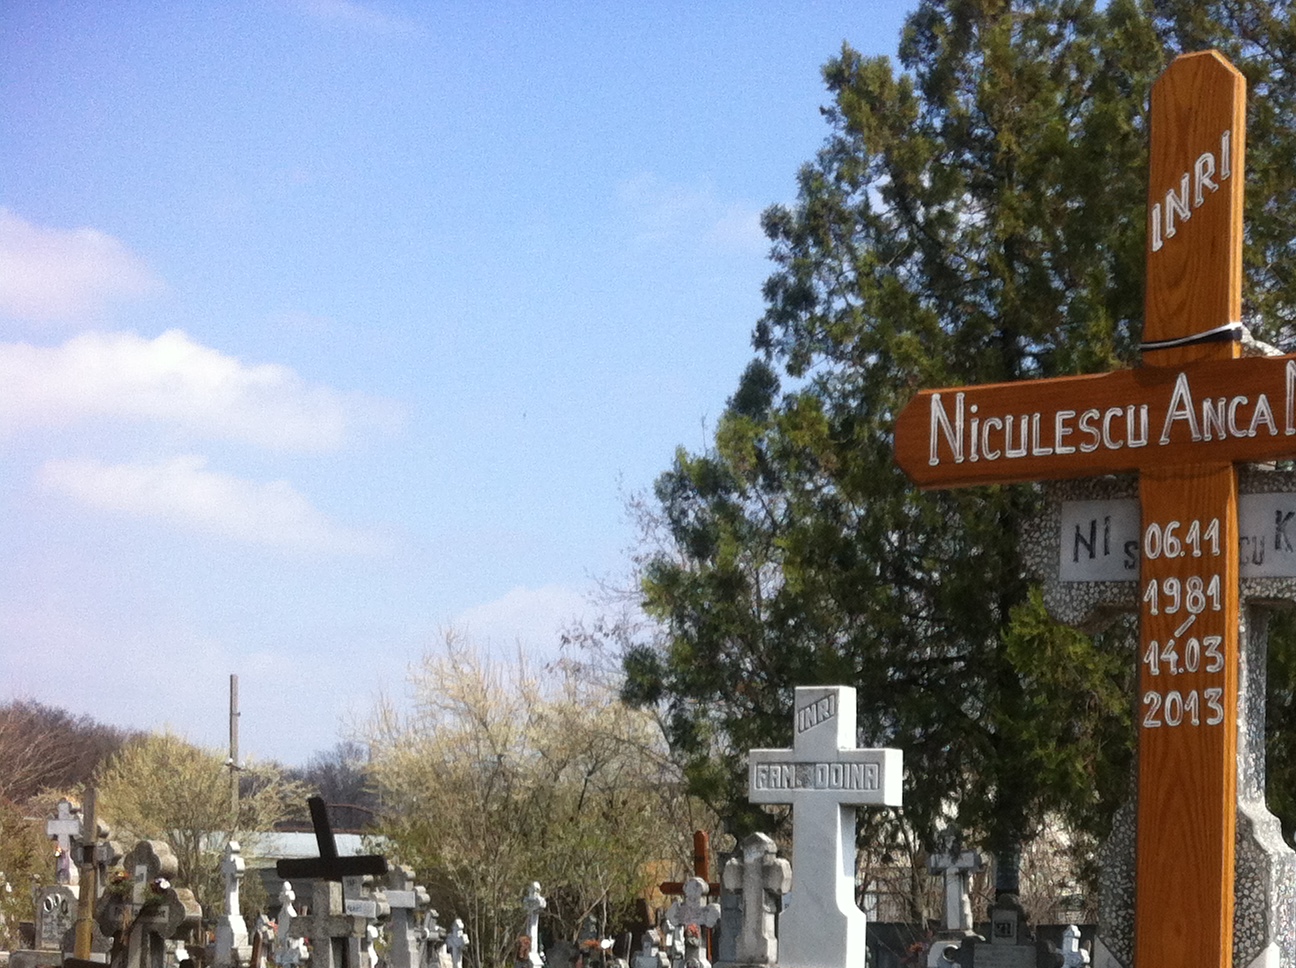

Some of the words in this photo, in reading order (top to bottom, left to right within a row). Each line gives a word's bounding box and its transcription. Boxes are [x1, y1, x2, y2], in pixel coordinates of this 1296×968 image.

[1151, 129, 1231, 253] INRI
[1158, 371, 1278, 446] ANCA
[1143, 517, 1221, 559] 06.11
[1143, 573, 1221, 616] 1981
[1143, 635, 1224, 676] 14.03
[797, 694, 836, 733] INRI
[1142, 687, 1224, 728] 2013
[815, 763, 879, 790] DOINA
